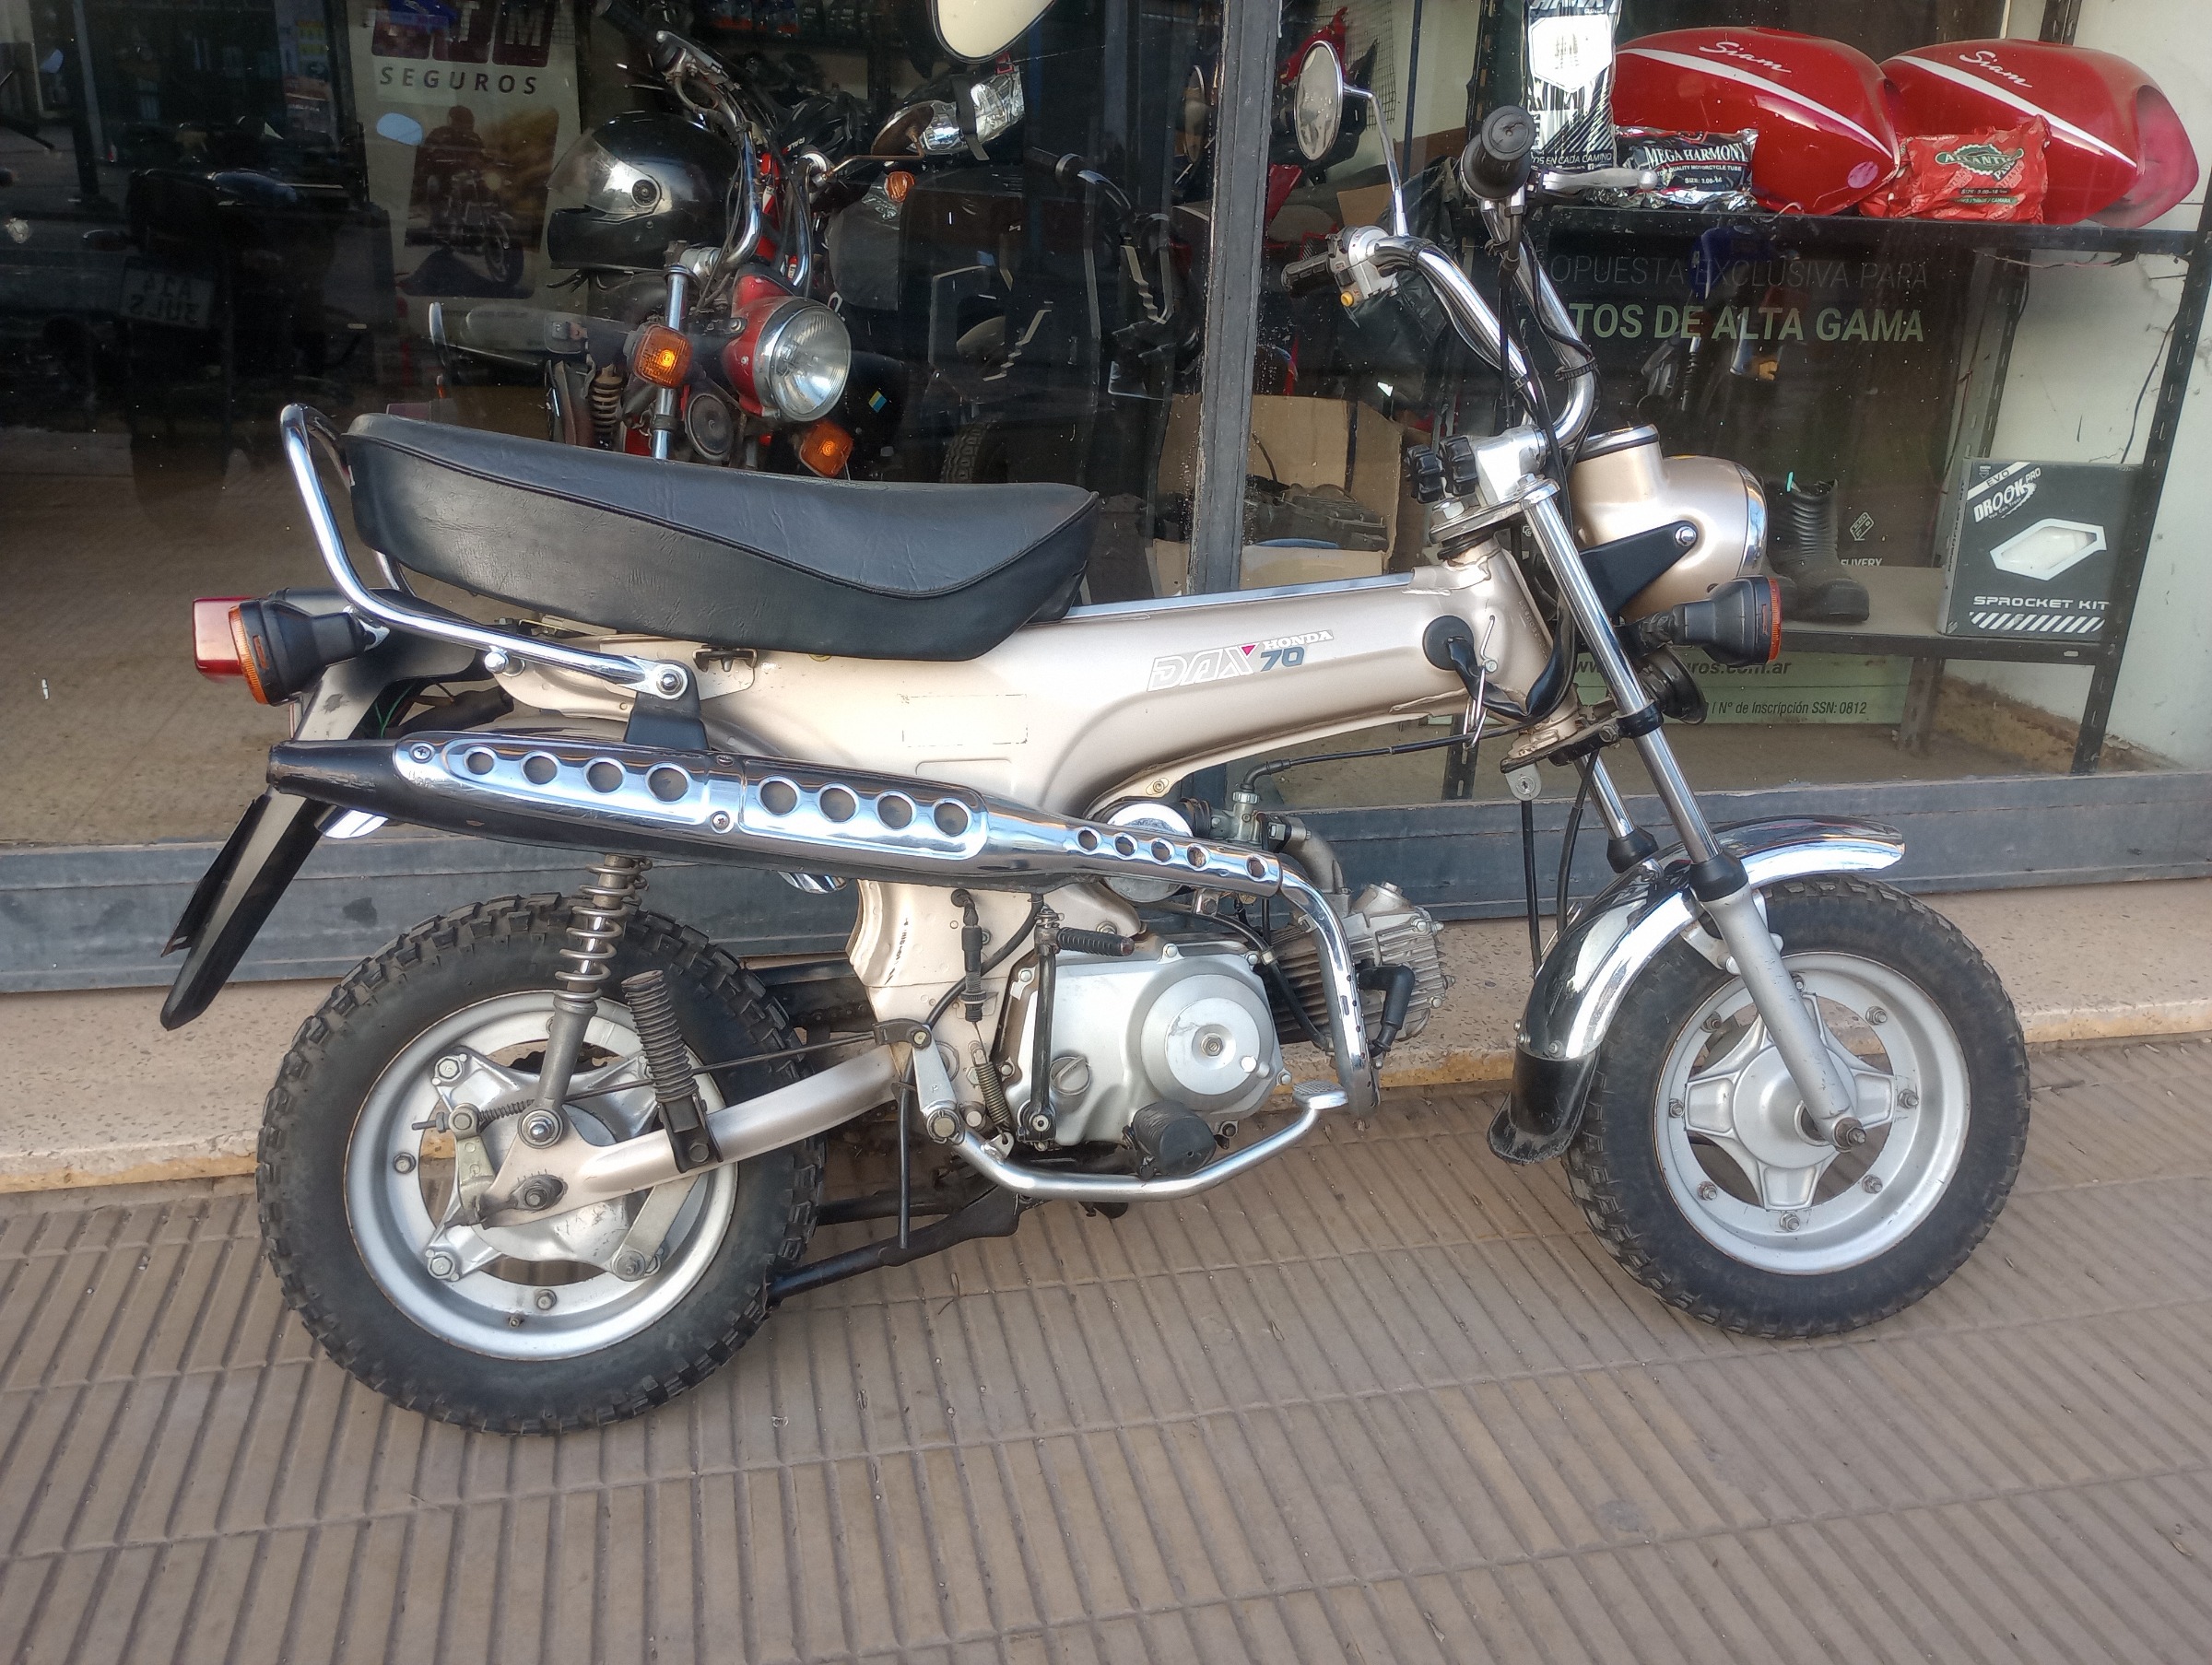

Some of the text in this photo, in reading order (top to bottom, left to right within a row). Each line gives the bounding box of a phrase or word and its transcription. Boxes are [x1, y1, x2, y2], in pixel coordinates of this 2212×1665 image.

[1699, 41, 1792, 74] Siam
[1959, 49, 2033, 88] Siam
[379, 65, 537, 95] SEGUROS
[1546, 156, 1558, 166] EN
[1558, 154, 1581, 165] CADA
[1582, 152, 1613, 163] CAMINO
[1643, 142, 1747, 169] MEGA HARMONY
[1549, 254, 1928, 289] OPUESTA EXCLUSIVA PARA
[1569, 302, 1924, 342] TOS DE ALTA GAMA
[1986, 469, 2010, 487] EVO
[2025, 467, 2041, 483] PRO
[1840, 557, 1884, 568] ELIVERY
[1972, 595, 2111, 612] SPROCKET KIT
[1147, 629, 1334, 692] DAX HONDA
[1260, 646, 1305, 673] 70
[1735, 700, 1748, 714] de
[1751, 700, 1809, 717] Inscripción
[1811, 701, 1837, 715] SSN:
[1839, 701, 1867, 715] 0812
